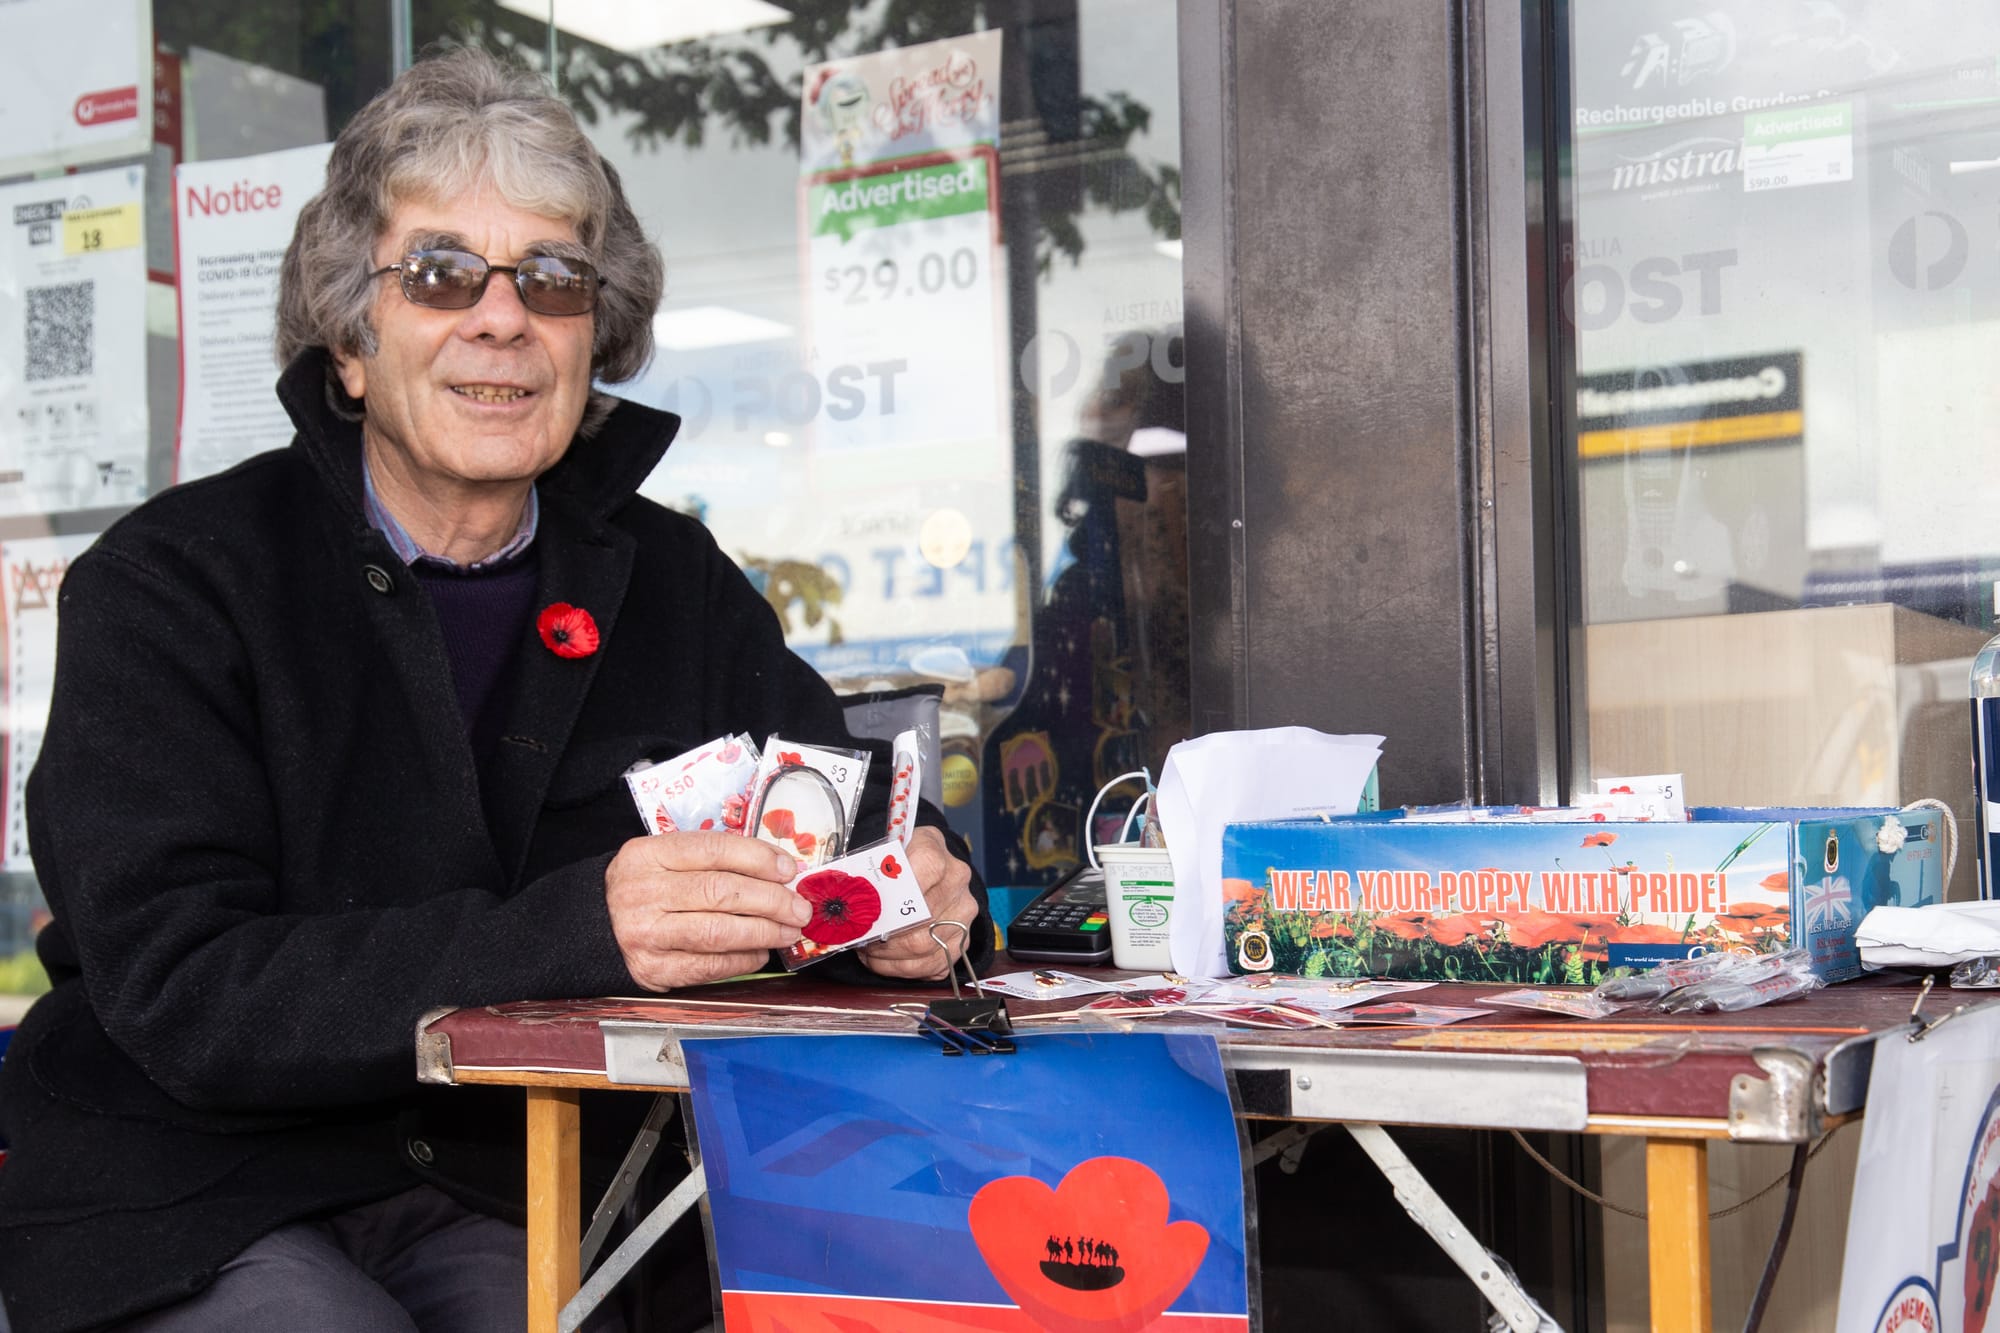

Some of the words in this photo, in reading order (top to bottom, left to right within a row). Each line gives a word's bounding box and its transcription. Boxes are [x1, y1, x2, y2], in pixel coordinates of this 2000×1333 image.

[1576, 97, 1726, 126] Rechargeable
[1754, 112, 1844, 137] Advertised
[1612, 137, 1744, 191] mistral
[187, 182, 282, 218] Notice
[820, 166, 977, 214] Advertised
[825, 247, 978, 304] $29.00
[1562, 248, 1739, 331] OST
[731, 358, 908, 433] POST
[830, 763, 849, 784] $3
[1640, 803, 1655, 818] $5
[1657, 785, 1673, 800] $5
[900, 899, 917, 917] $5
[1271, 870, 1351, 911] WEAR
[1357, 870, 1433, 912] YOUR
[1439, 870, 1532, 913] POPPY
[1540, 871, 1621, 914] WITH
[1629, 871, 1730, 915] PRIDE!
